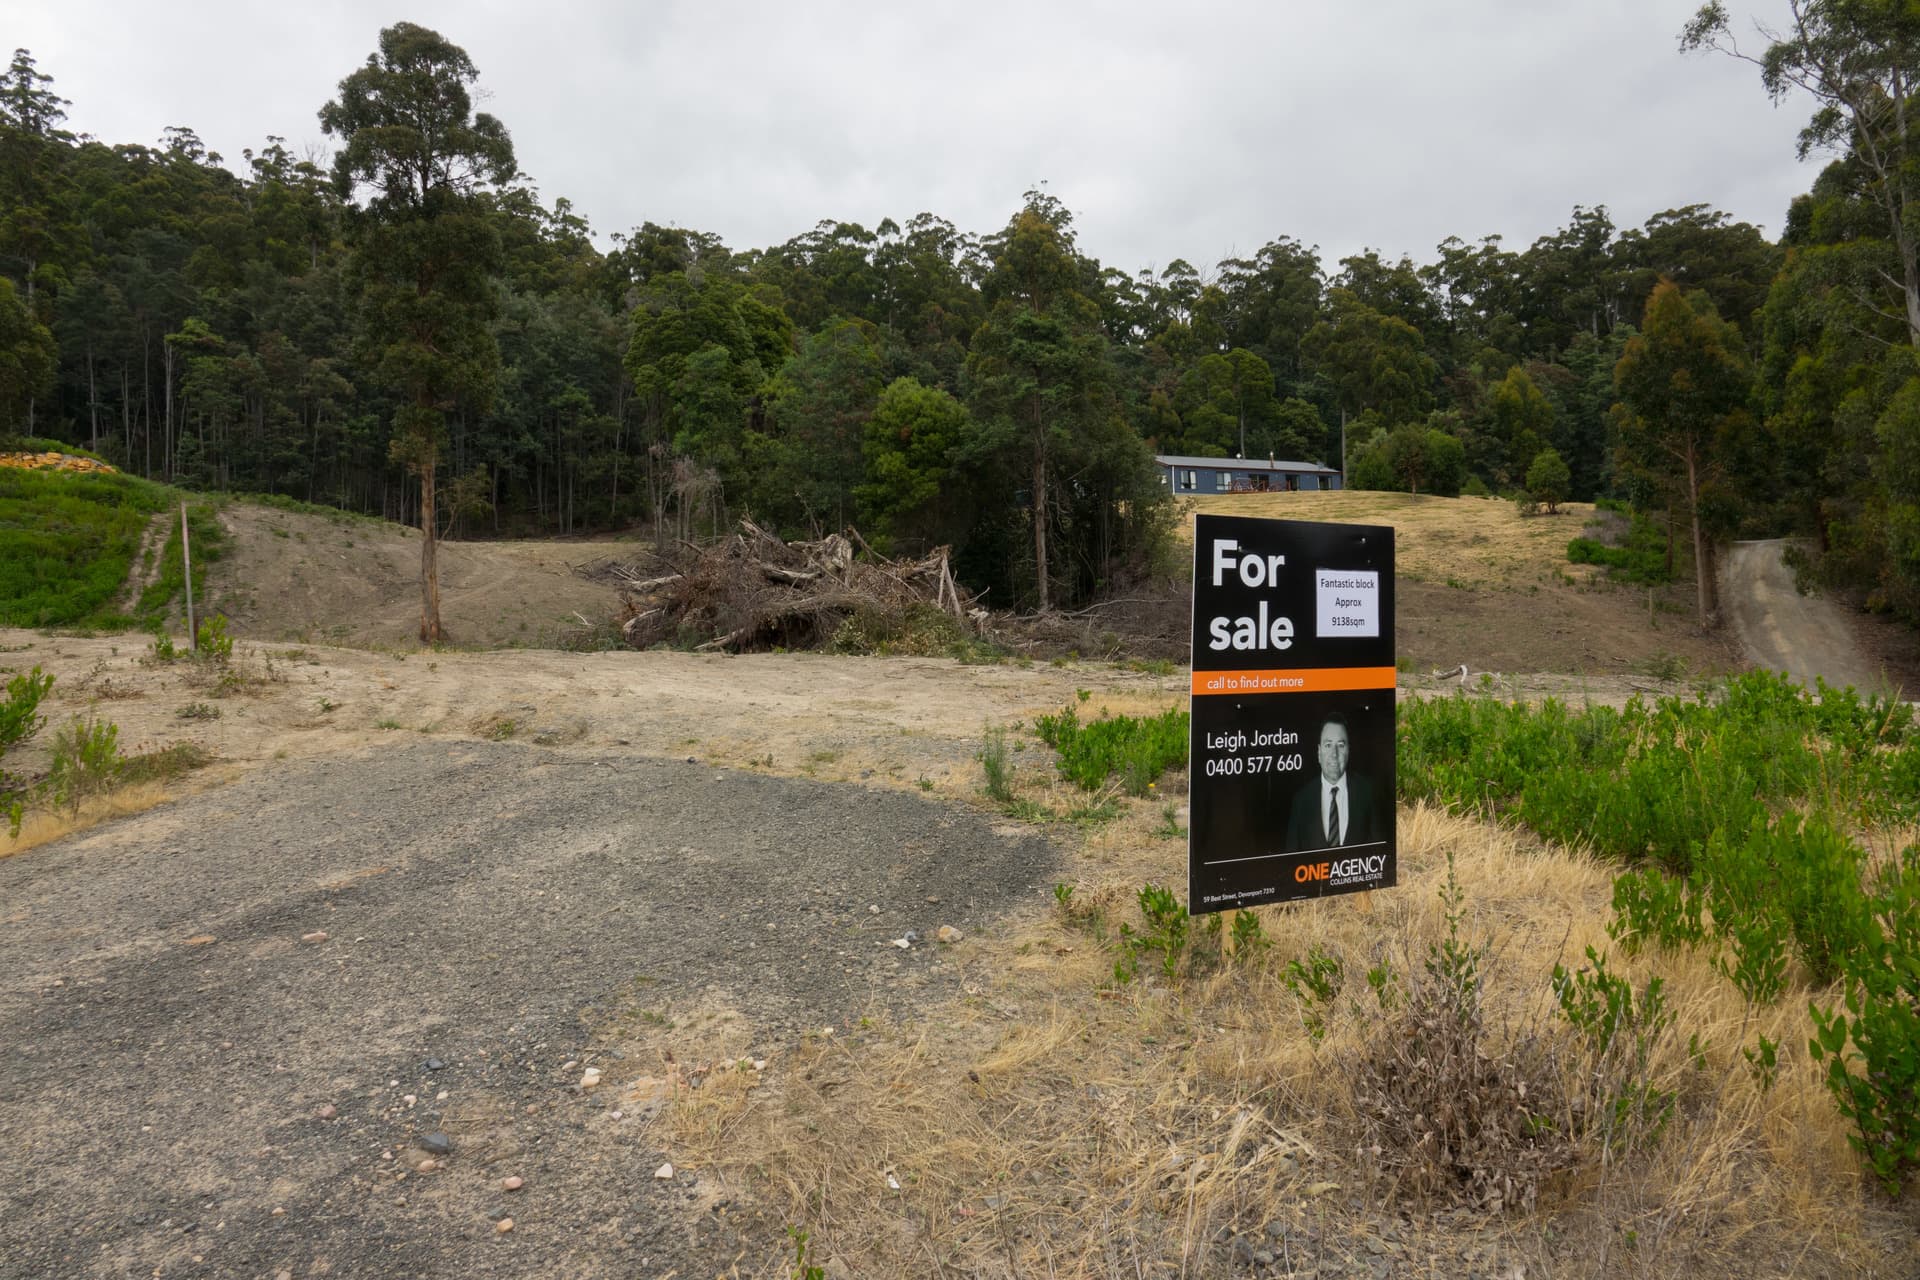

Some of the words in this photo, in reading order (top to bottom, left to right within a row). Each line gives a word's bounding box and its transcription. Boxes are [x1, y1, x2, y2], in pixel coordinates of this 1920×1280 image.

[1213, 539, 1285, 587] For
[1320, 578, 1354, 589] Fantastic
[1355, 578, 1375, 589] block
[1335, 597, 1362, 608] Approx
[1209, 601, 1294, 650] sale
[1331, 616, 1365, 628] 9138sqm
[1207, 676, 1225, 689] call
[1227, 677, 1238, 689] to
[1240, 675, 1259, 688] find
[1261, 676, 1277, 688] out
[1279, 678, 1304, 687] more
[1207, 730, 1246, 752] Leigh
[1250, 728, 1298, 746] Jordan
[1206, 758, 1243, 776] 0400
[1247, 756, 1273, 774] 577
[1277, 753, 1302, 771] 660
[1330, 878, 1352, 886] COLLINS
[1352, 875, 1365, 883] REAL
[1365, 872, 1383, 881] ESTATE
